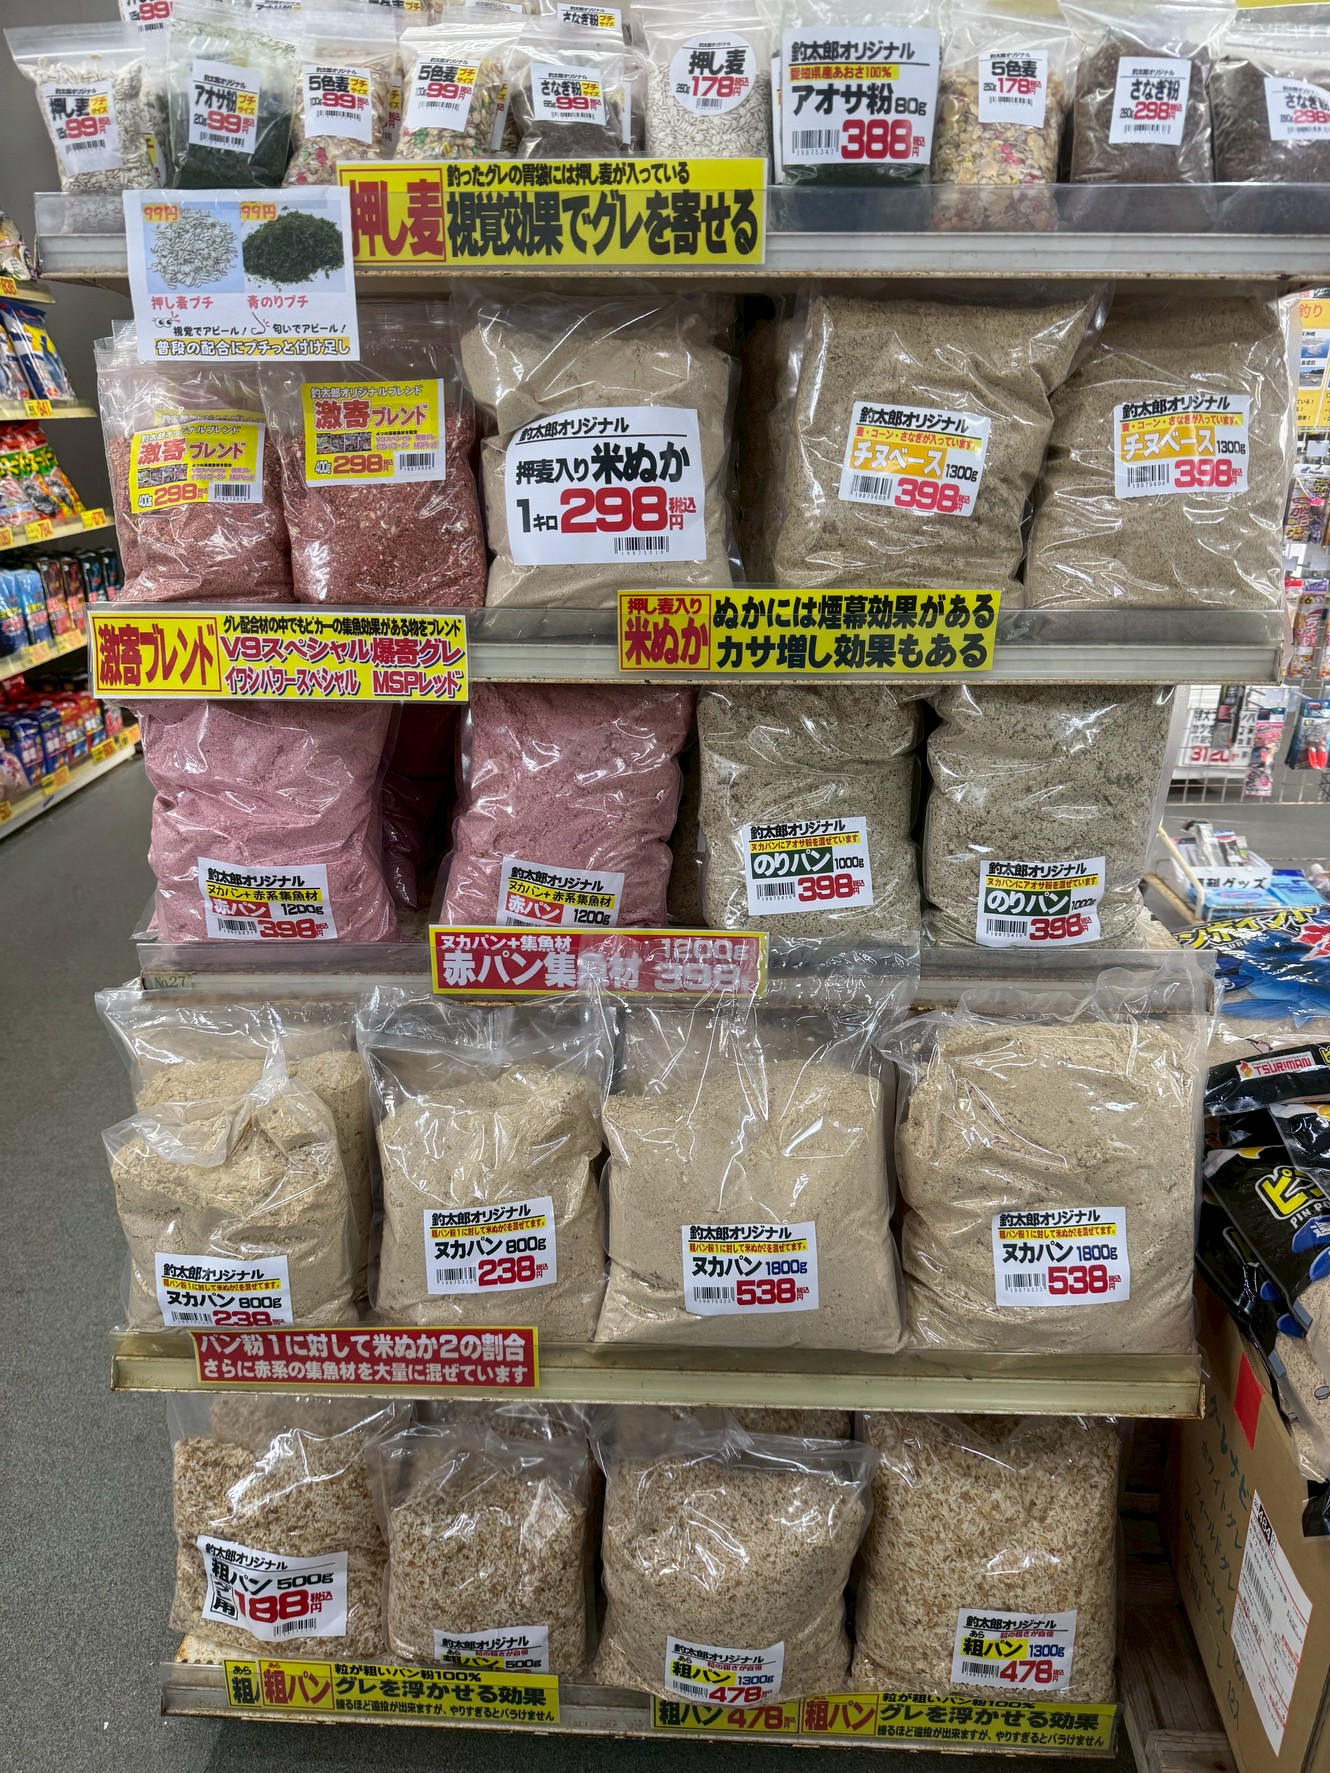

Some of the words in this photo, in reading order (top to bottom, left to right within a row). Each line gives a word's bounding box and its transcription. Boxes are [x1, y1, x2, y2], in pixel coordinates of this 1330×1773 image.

[138, 1, 171, 21] 99
[562, 11, 599, 26] さなぎ粉
[688, 49, 746, 75] 押し麦
[791, 40, 915, 62] 釣太郎オリジナル
[418, 65, 459, 83] 5色麦
[790, 67, 892, 80] 愛知県産あおさ100%
[991, 60, 1038, 78] 5色麦
[309, 75, 350, 92] 5色麦
[426, 82, 460, 99] 99
[541, 80, 582, 96] さなぎ粉
[692, 76, 735, 97] 178
[997, 77, 1030, 94] 178
[1130, 79, 1180, 101] さなぎ粉
[49, 97, 90, 121] 押し麦
[195, 84, 238, 113] アオサ粉
[322, 92, 357, 109] 99
[556, 96, 590, 109] 99
[792, 83, 894, 116] アオサ粉
[894, 97, 928, 116] 80g
[207, 110, 242, 133] 99
[1133, 101, 1170, 120] 298
[1293, 109, 1328, 124] 298
[65, 116, 98, 139] 99
[841, 119, 913, 159] 388
[447, 162, 690, 187] 釣ったグレの胃袋には押し麦が入っている
[143, 205, 179, 219] 99円
[240, 203, 277, 220] 99円
[349, 178, 445, 258] 押し麦
[447, 188, 760, 258] 視覚効果でグレを寄せる
[151, 296, 214, 310] 押し麦プチ
[247, 295, 309, 309] 青のりプチ
[173, 326, 247, 337] 視覚でアピール！
[272, 323, 347, 335] 匂いでアピール！
[155, 340, 350, 356] 普段の配合にプチっと付け足し
[311, 384, 423, 399] 釣太郎オリジナルブレンド
[313, 399, 428, 431] 激寄ブレンド
[1122, 396, 1230, 419] 釣太郎オリジナル
[519, 417, 630, 442] 釣太郎オリジナル
[859, 406, 969, 434] 釣太郎オリジナル
[140, 425, 241, 443] 釣太郎オリジナルブレンド
[1123, 429, 1214, 461] チヌベース
[1217, 440, 1246, 454] 1300g
[137, 437, 246, 466] 激寄ブレンド
[516, 441, 690, 485] 押麦入り米ぬか
[853, 441, 943, 476] チヌベース
[946, 464, 978, 482] 1300g
[315, 460, 332, 475] 400g
[333, 454, 383, 475] 298
[1174, 458, 1232, 488] 398
[154, 483, 198, 507] 298
[894, 477, 960, 513] 398
[516, 498, 558, 533] 1キロ
[560, 485, 669, 534] 298
[669, 496, 697, 514] 税込
[669, 514, 684, 531] 円
[627, 597, 703, 616] 押し麦入り
[713, 594, 995, 630] ぬかには煙幕効果がある
[625, 616, 709, 666] 米ぬか
[717, 633, 989, 669] カサ増し効果もある
[99, 623, 216, 687] 激寄ブレンド
[225, 664, 361, 697] イワシパワースペシャル
[372, 668, 465, 697] MSPレッド
[750, 819, 846, 840] 釣太郎オリジナル
[751, 833, 858, 852] ヌカパンにアオサ粉を混ぜています
[753, 849, 831, 876] のりパン
[835, 856, 864, 870] 1000g
[988, 861, 1087, 878] 釣太郎オリジナル
[207, 867, 305, 888] 釣太郎オリジナル
[511, 866, 605, 892] 釣太郎オリジナル
[797, 873, 854, 902] 398
[987, 876, 1097, 889] ヌカパンにアオサ粉を混ぜています
[207, 884, 318, 902] ヌカパン+赤系集魚材
[508, 880, 612, 908] ヌカパン+赤系集魚材
[986, 890, 1069, 914] のりパン
[1071, 898, 1097, 912] 1000g
[212, 898, 267, 917] 赤パン
[281, 903, 324, 916] 1200g
[508, 895, 561, 920] 赤パン
[573, 908, 611, 926] 1200g
[257, 918, 317, 939] 398
[1029, 913, 1083, 940] 398
[441, 934, 572, 953] ヌカパン+集魚材
[659, 938, 749, 961] 1200g
[653, 962, 742, 991] 398
[430, 1203, 532, 1226] 釣太郎オリジナル
[999, 1209, 1101, 1227] 釣太郎オリジナル
[1290, 1208, 1312, 1229] PIN
[689, 1225, 792, 1241] 釣太郎オリジナル
[434, 1236, 503, 1260] ヌカパン
[505, 1236, 547, 1254] 800g
[1002, 1240, 1074, 1264] ヌカパン
[1076, 1244, 1118, 1261] 1800g
[163, 1262, 265, 1281] 釣太郎オリジナル
[478, 1255, 536, 1287] 238
[692, 1255, 762, 1278] ヌカパン
[765, 1259, 808, 1276] 1800g
[1048, 1264, 1109, 1295] 538
[166, 1290, 236, 1308] ヌカパン
[238, 1296, 282, 1309] 800g
[736, 1278, 796, 1306] 538
[212, 1310, 273, 1327] 238
[200, 1332, 527, 1362] パン粉1に対して米ぬか2の割合
[203, 1358, 528, 1384] さらに赤系の集魚材を大量に混ぜています
[205, 1542, 288, 1570] 釣太郎オリジナル
[211, 1557, 273, 1596] 粗パン
[276, 1571, 334, 1590] 500g
[234, 1589, 310, 1624] 188
[310, 1590, 333, 1603] 税込
[310, 1602, 322, 1614] 円
[965, 1615, 1057, 1630] 釣太郎オリジナル
[969, 1629, 985, 1638] あら
[442, 1635, 529, 1650] 釣太郎オリジナル
[673, 1643, 764, 1664] 釣太郎オリジナル
[962, 1637, 1023, 1658] 粗パン
[1029, 1644, 1065, 1658] 1300g
[233, 1666, 252, 1675] あら
[334, 1664, 482, 1683] 粒が粗いパン粉100%
[505, 1659, 542, 1668] 500g
[672, 1661, 731, 1684] 粗パン
[737, 1674, 774, 1686] 1300g
[999, 1659, 1053, 1684] 478
[263, 1669, 332, 1705] 粗パン
[335, 1678, 548, 1707] グレを浮かせる効果
[708, 1686, 763, 1703] 478
[727, 1706, 783, 1729] 478
[882, 1692, 1035, 1709] 粒が粗いパン粉100%
[804, 1700, 876, 1731] 粗パン
[880, 1704, 1100, 1731] グレを浮かせる効果
